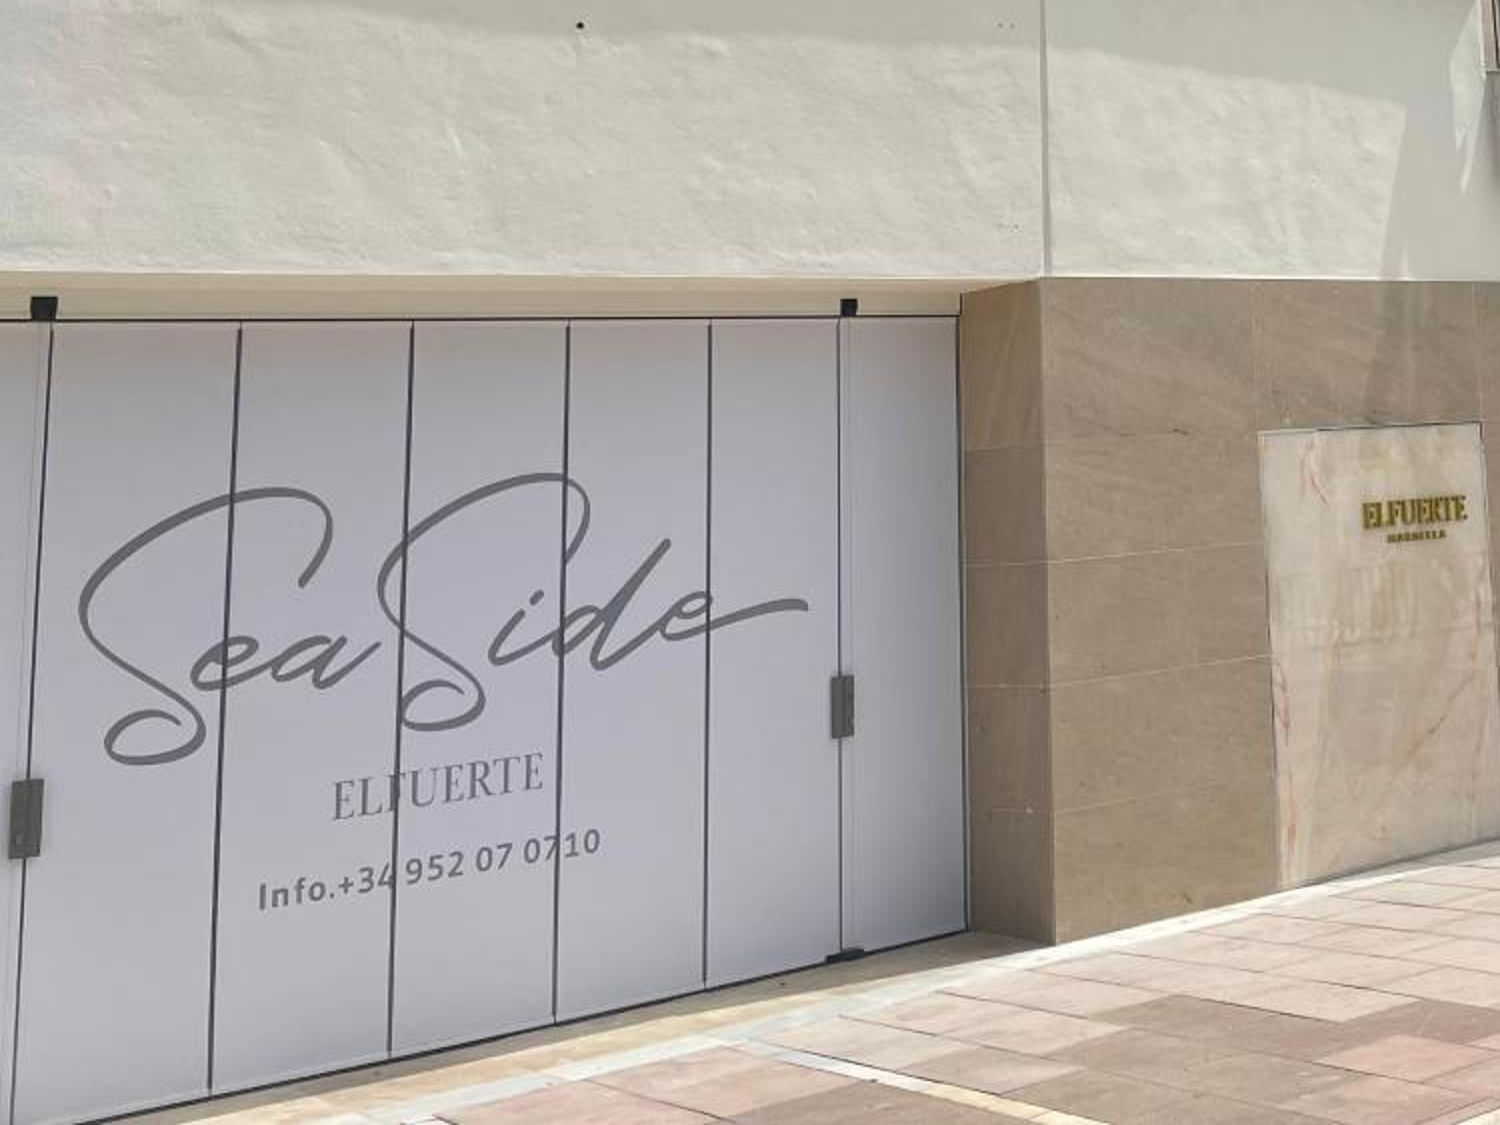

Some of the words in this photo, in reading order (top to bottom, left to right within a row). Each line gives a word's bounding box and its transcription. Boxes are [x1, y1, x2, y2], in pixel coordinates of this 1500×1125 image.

[405, 851, 464, 886] 952
[475, 843, 514, 873] 07
[523, 828, 601, 865] 0710
